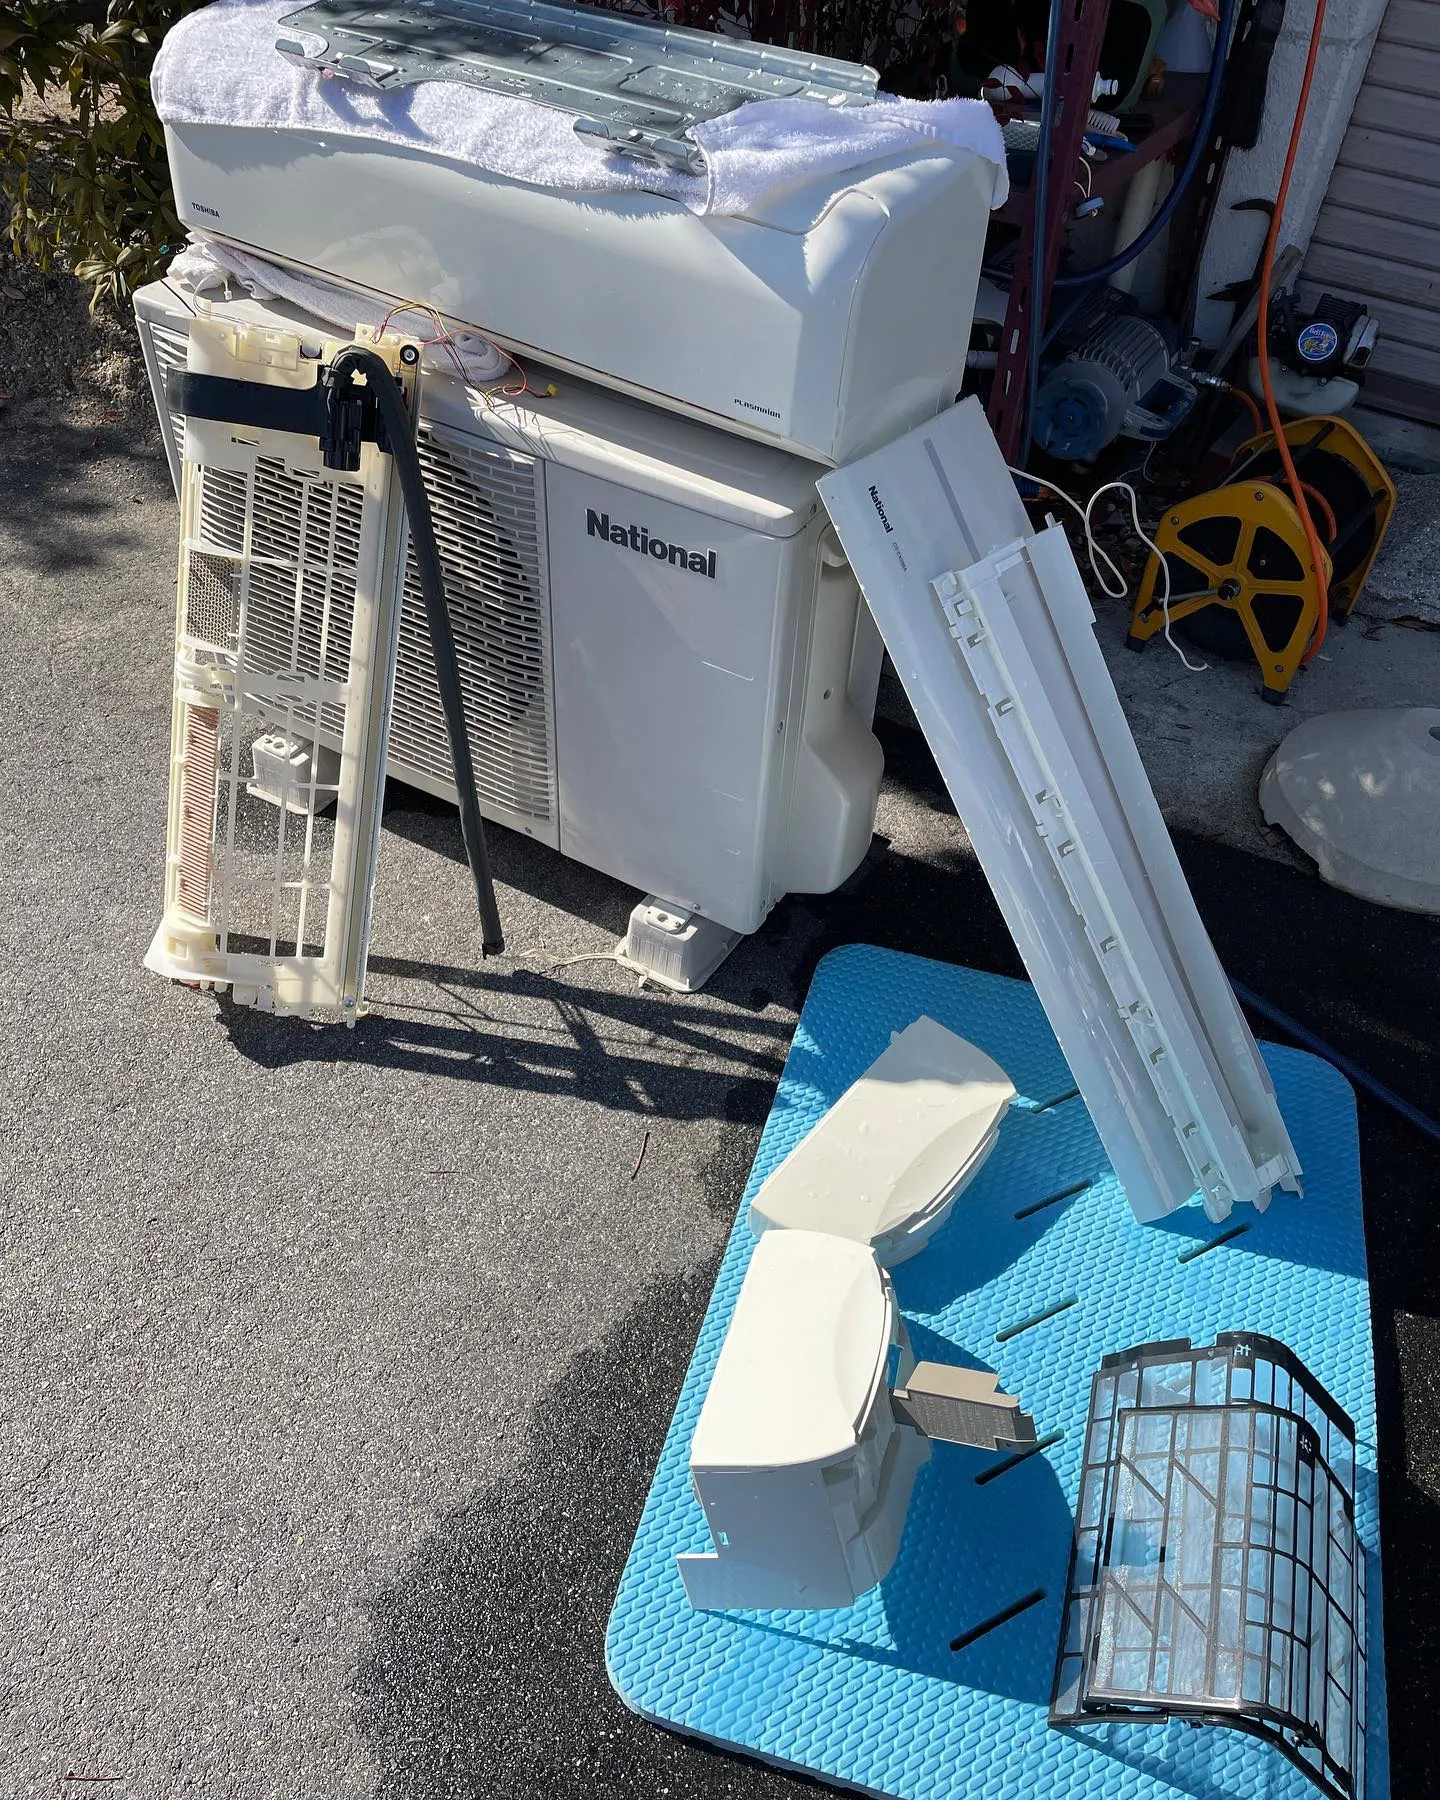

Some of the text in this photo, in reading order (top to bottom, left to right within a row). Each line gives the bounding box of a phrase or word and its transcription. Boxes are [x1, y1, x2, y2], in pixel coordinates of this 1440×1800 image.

[191, 202, 220, 218] TOSHIBA
[868, 485, 894, 533] National
[586, 508, 717, 579] National
